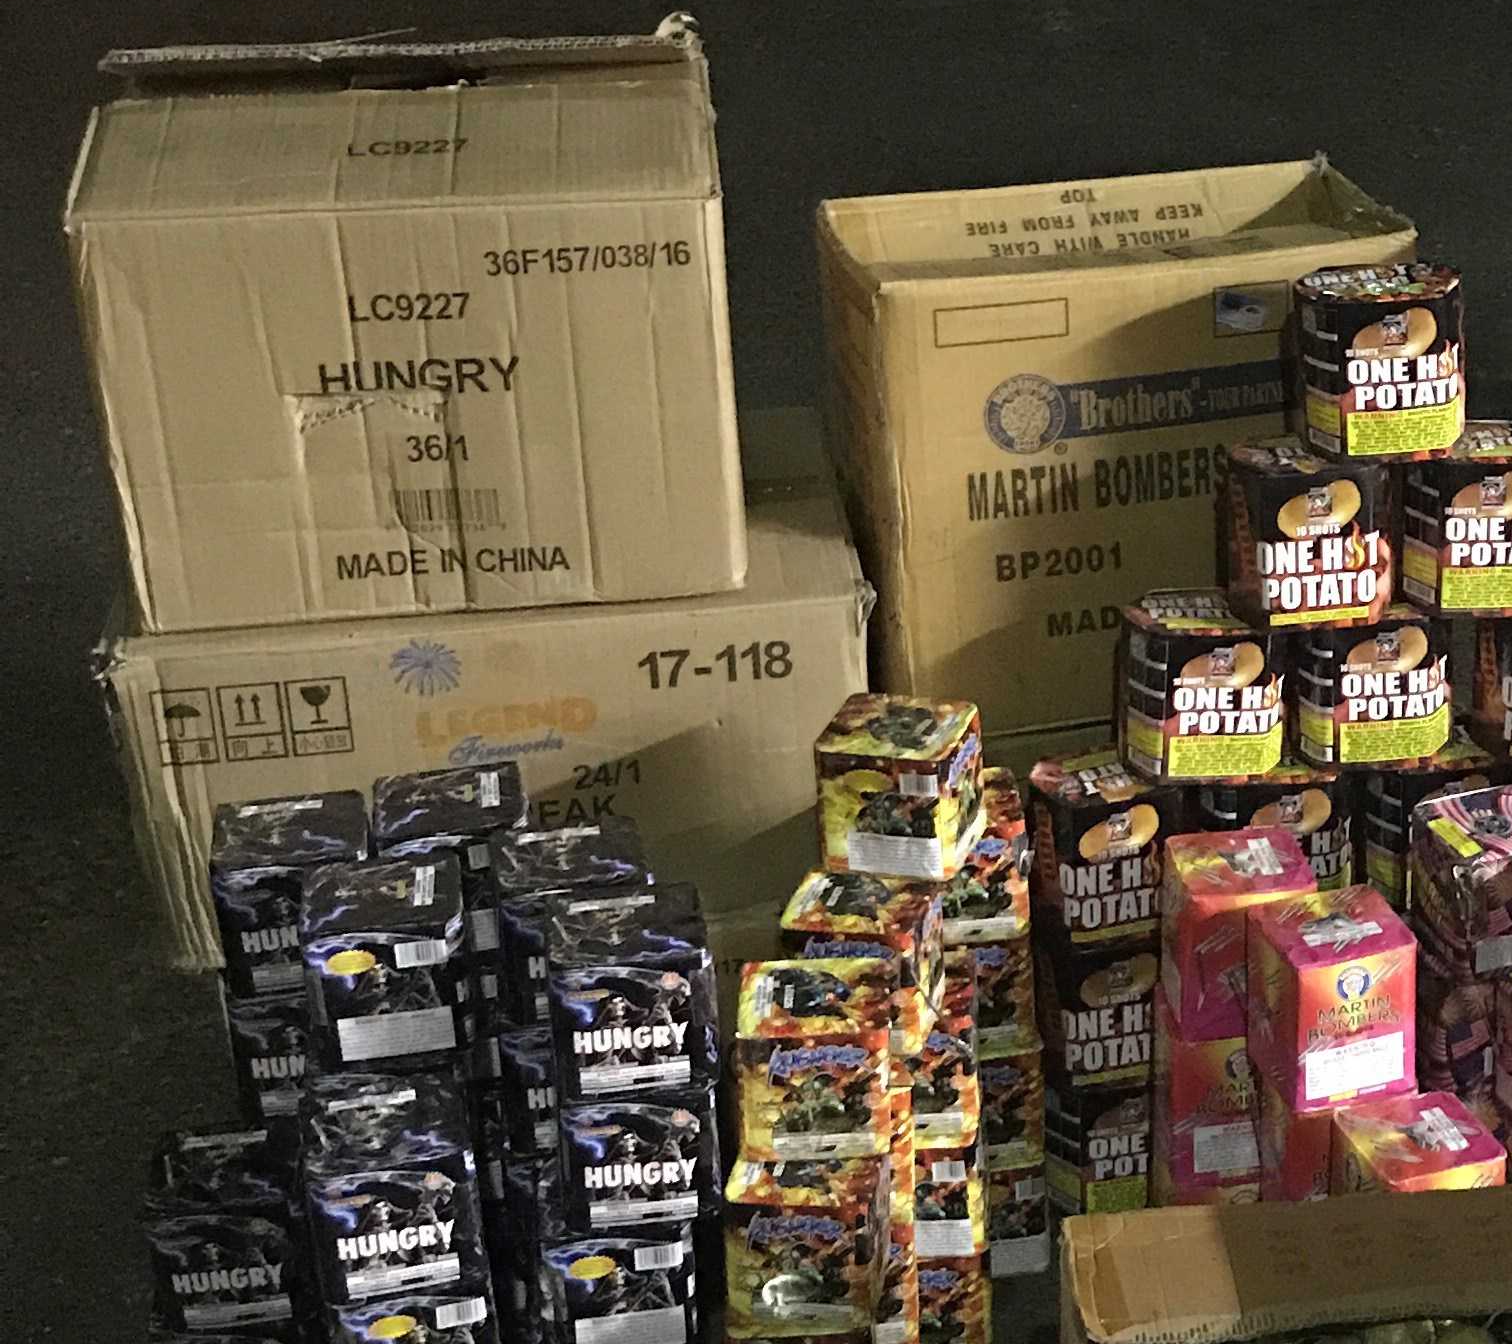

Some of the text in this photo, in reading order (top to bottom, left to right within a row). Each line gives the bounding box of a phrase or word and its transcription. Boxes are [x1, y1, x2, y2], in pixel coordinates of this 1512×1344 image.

[347, 138, 469, 158] LC9227
[1060, 188, 1096, 204] TOP
[966, 203, 1204, 237] KEEP AWAY FROM FIRE
[485, 241, 692, 277] 36F157/038/16
[988, 228, 1190, 258] HANDLE WITH CARE
[350, 292, 470, 323] LC9227
[319, 356, 520, 394] HUNGRY
[1347, 358, 1409, 385] ONE
[406, 434, 469, 463] 36/1
[967, 443, 1233, 521] MARTIN BOMBERS
[1309, 523, 1341, 535] SHOTS
[1446, 516, 1505, 542] ONE
[337, 547, 570, 582] MADE IN CHINA
[996, 541, 1123, 582] BP2001
[1257, 529, 1380, 576] ONE HOT
[1262, 568, 1377, 610] POTATO
[1047, 606, 1122, 638] MAD
[638, 640, 793, 690] 17-118
[1174, 687, 1234, 712] ONE
[1342, 673, 1401, 698] ONE
[574, 758, 641, 790] 24/1
[538, 792, 616, 826] EAK
[1059, 862, 1113, 896] ONE
[1062, 886, 1160, 929] POTAT
[241, 925, 299, 955] HUN
[1318, 993, 1391, 1020] MARTIN
[573, 1021, 688, 1055] HUNGRY
[1062, 1008, 1117, 1041] ONE
[1308, 1008, 1400, 1041] BOMBERS
[252, 1054, 305, 1080] HUN
[1065, 1038, 1151, 1073] POTAT
[1088, 1134, 1147, 1161] ONE
[584, 1156, 698, 1189] HUNGRY
[1094, 1152, 1148, 1180] POT
[336, 1218, 454, 1262] HUNGRY
[172, 1262, 282, 1295] HUNGRY
